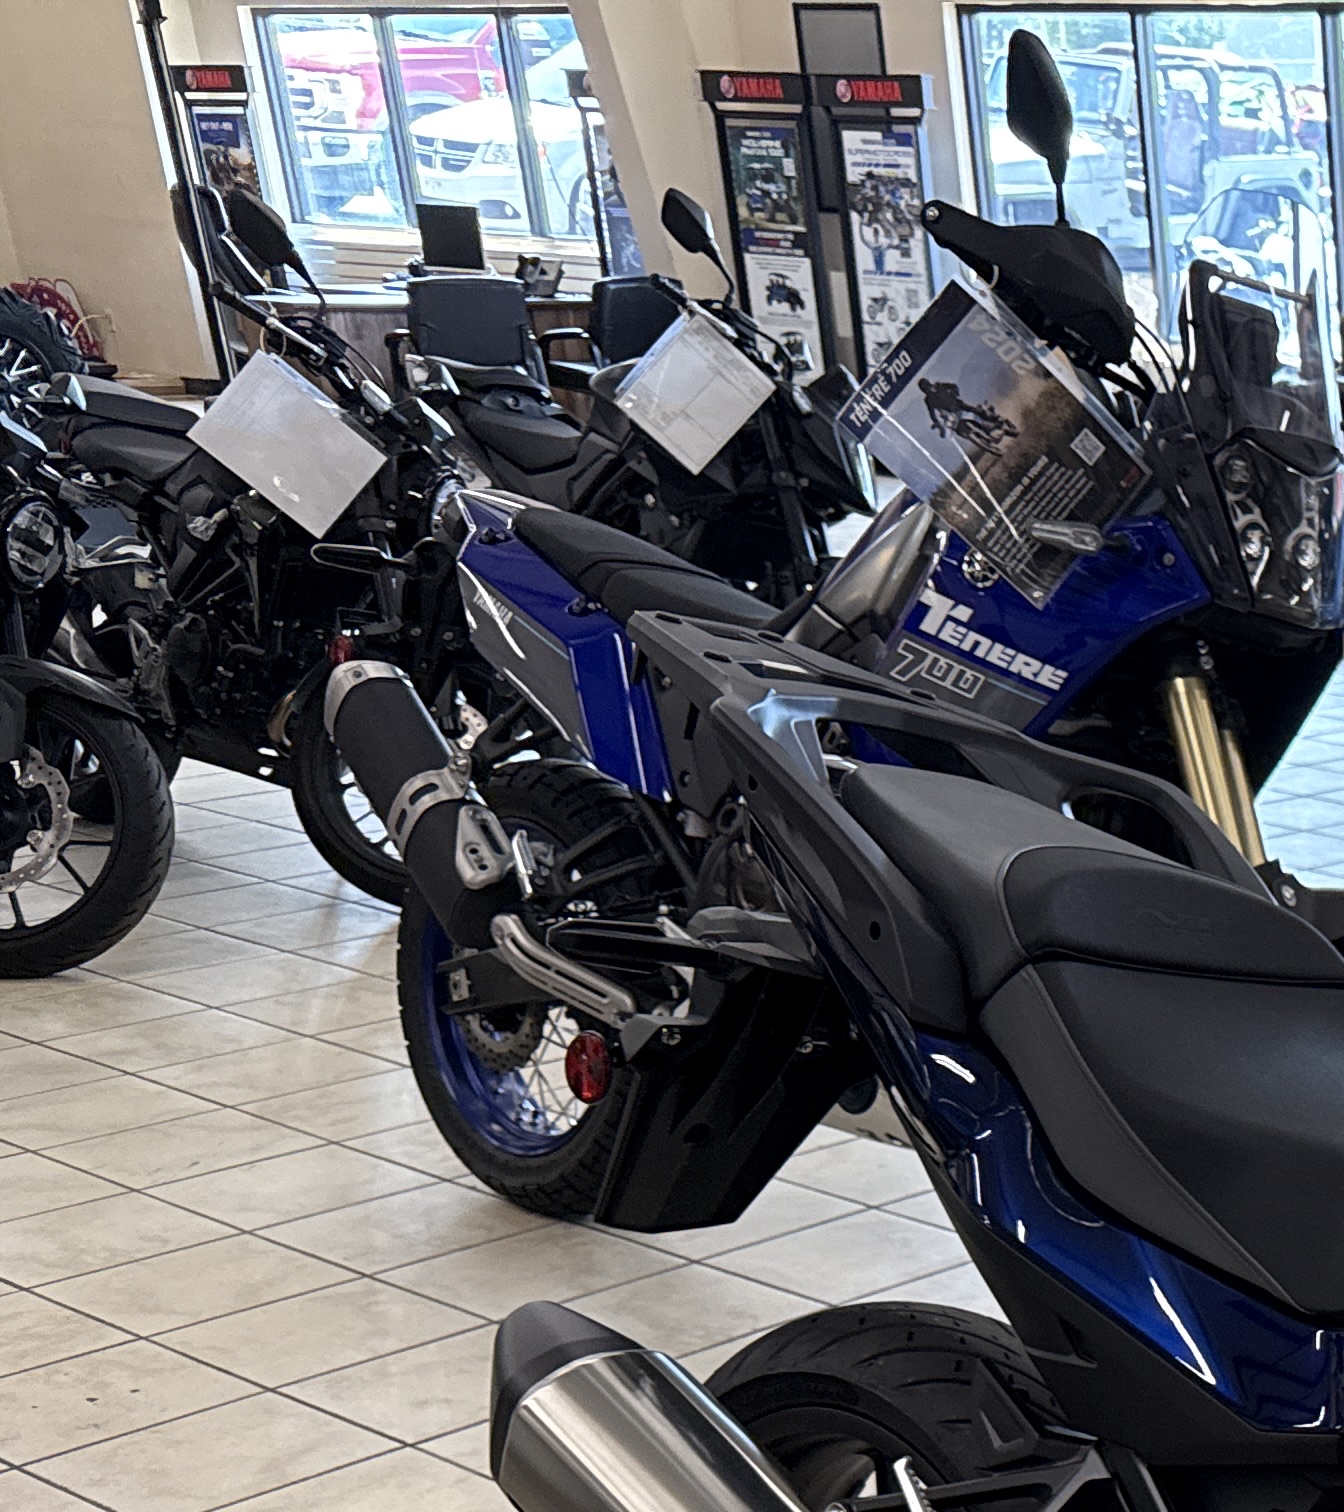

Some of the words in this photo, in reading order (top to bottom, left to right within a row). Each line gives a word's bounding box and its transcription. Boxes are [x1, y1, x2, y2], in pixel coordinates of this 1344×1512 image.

[733, 76, 784, 99] YAMAHA
[850, 80, 903, 102] YAMAHA
[885, 351, 913, 378] 700
[890, 638, 985, 699] 700
